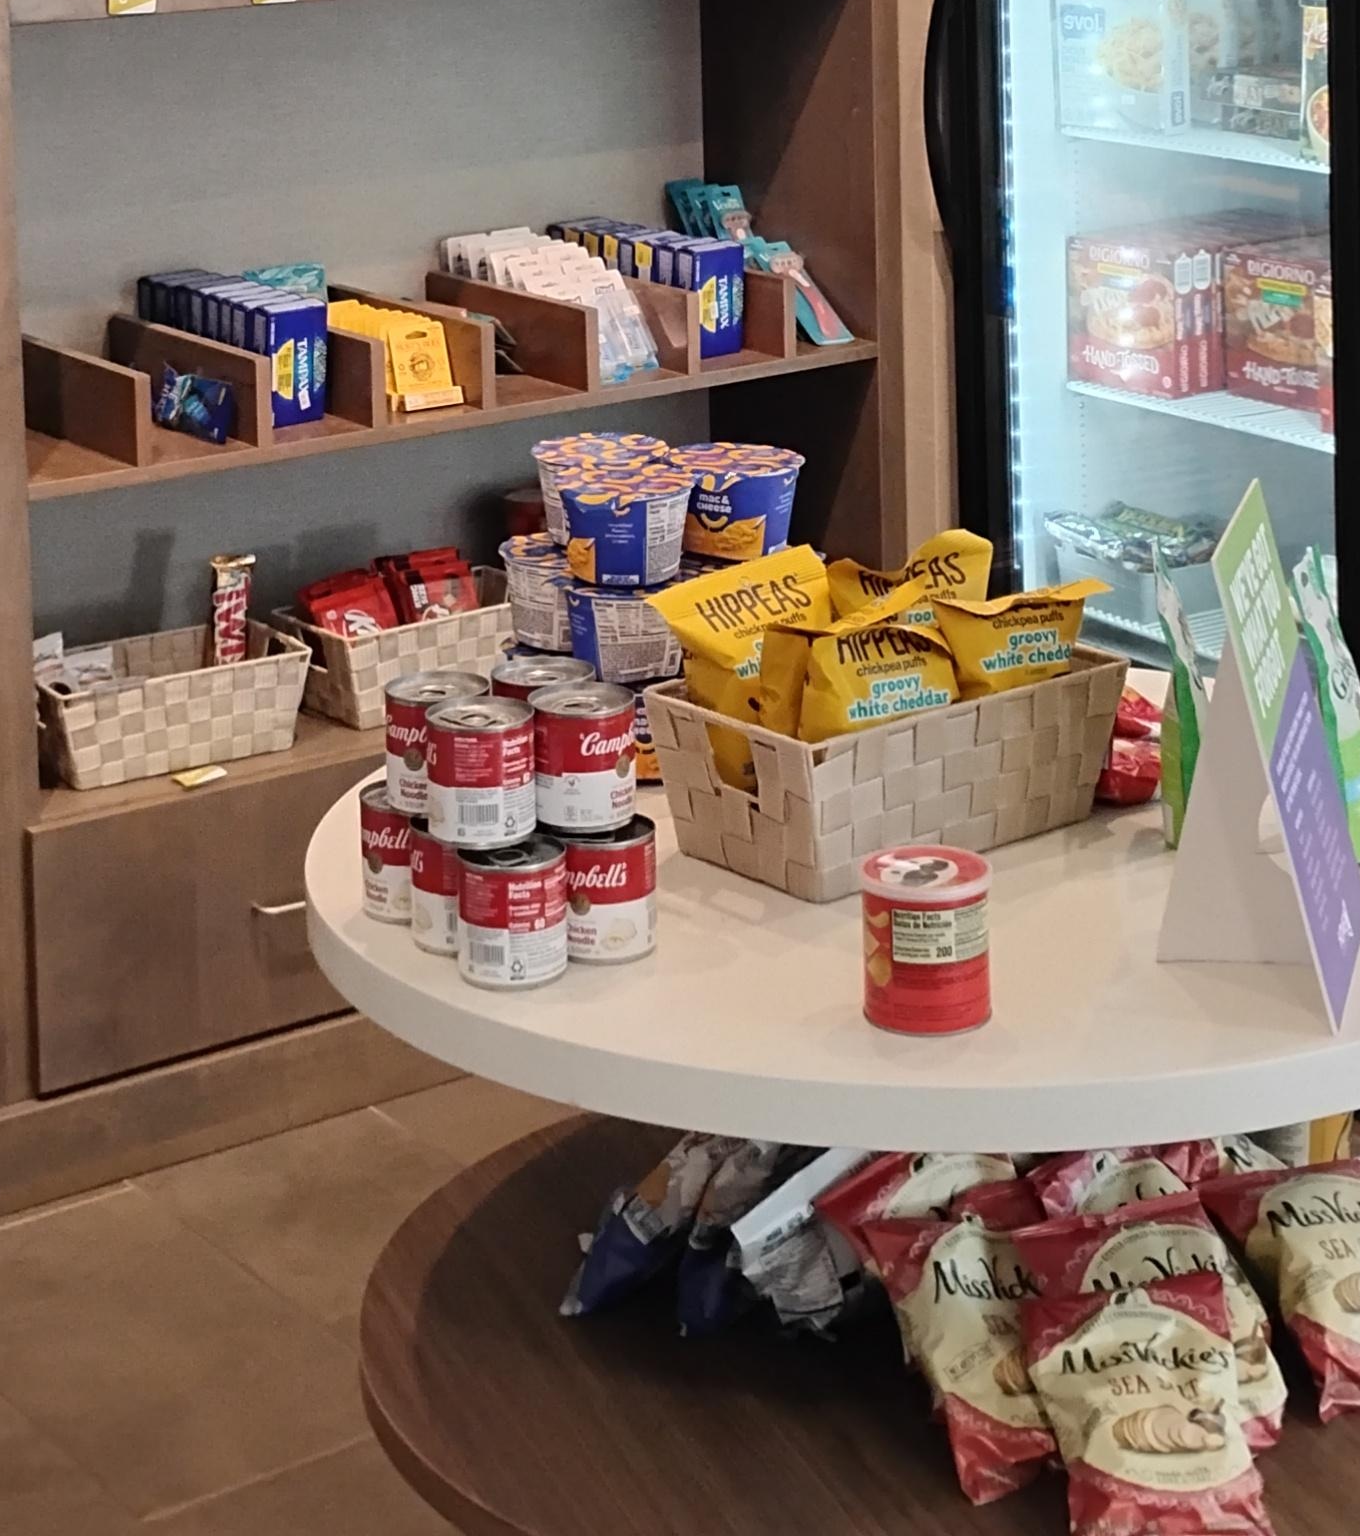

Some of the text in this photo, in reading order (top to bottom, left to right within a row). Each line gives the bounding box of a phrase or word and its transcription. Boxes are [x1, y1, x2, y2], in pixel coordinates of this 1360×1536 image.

[1247, 260, 1316, 285] DIGIORNO
[718, 275, 730, 329] TAMPAX
[699, 493, 730, 505] mac &
[695, 574, 812, 632] HIPPEAS
[992, 610, 1064, 630] chickpea puffs
[1008, 628, 1058, 651] groovy
[856, 655, 927, 677] chickpea puffs
[982, 649, 1024, 673] white
[872, 675, 921, 700] groovy
[892, 689, 949, 714] cheddar
[398, 777, 428, 791] Chicken
[399, 788, 428, 801] Noodle
[935, 945, 953, 958] 200
[1266, 1199, 1326, 1236] Miss
[1323, 1239, 1358, 1260] SEA
[932, 1260, 985, 1304] Miss
[1061, 1346, 1128, 1376] Miss
[1107, 1377, 1150, 1396] SEA
